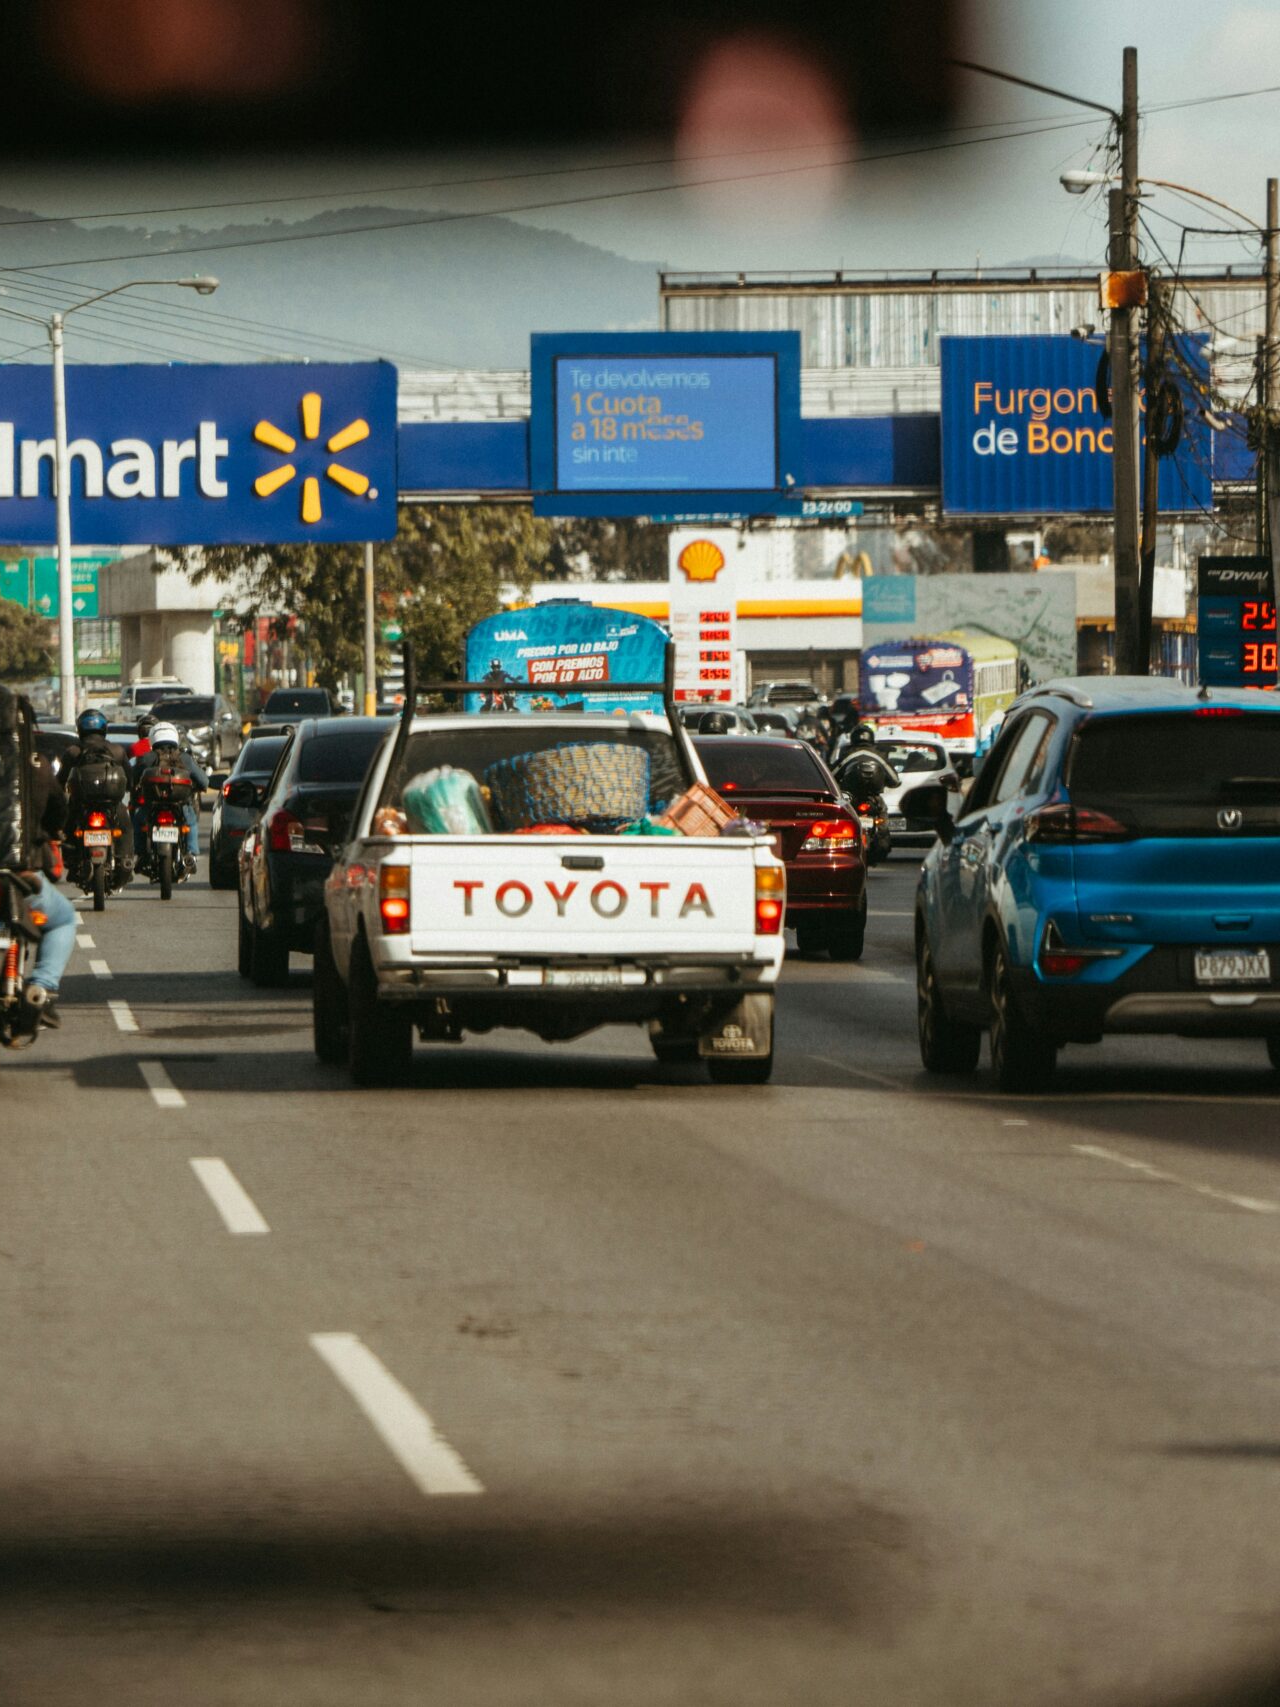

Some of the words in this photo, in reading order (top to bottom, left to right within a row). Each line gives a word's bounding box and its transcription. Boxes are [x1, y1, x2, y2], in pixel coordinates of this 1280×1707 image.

[570, 367, 592, 389] Te
[595, 367, 710, 389] devolvemos
[572, 393, 582, 416] 1
[586, 392, 661, 416] Cuota
[572, 423, 586, 441] a
[590, 418, 617, 441] 18
[973, 420, 1019, 456] de
[572, 446, 601, 464] sin
[557, 644, 578, 656] POR
[579, 642, 592, 653] LO
[593, 640, 619, 652] BAJO
[531, 660, 553, 673] CON
[555, 656, 604, 671] PREMIOS
[533, 672, 557, 684] POR
[559, 671, 575, 683] LO
[577, 668, 604, 681] ALTO
[453, 879, 715, 919] TOYOTA
